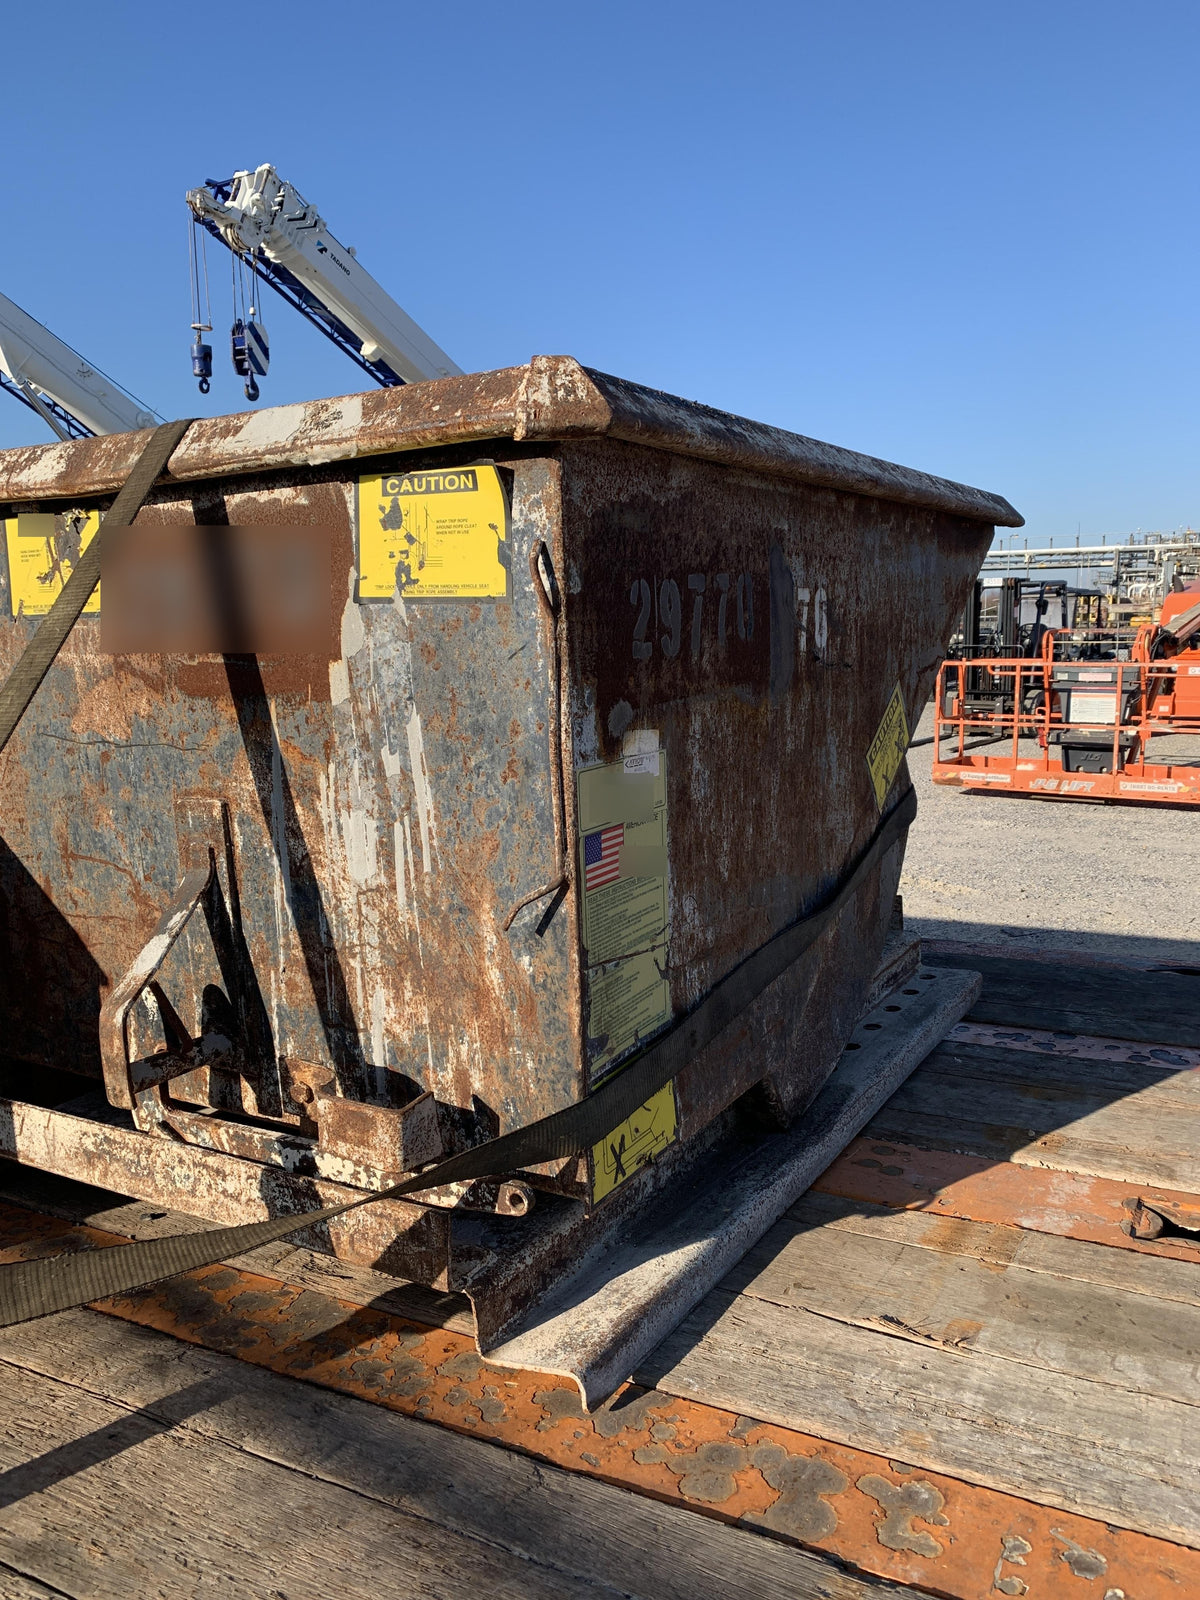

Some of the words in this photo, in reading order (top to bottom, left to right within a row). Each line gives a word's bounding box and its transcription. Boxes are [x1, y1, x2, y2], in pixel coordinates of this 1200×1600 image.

[330, 253, 351, 276] TADANO
[386, 473, 473, 494] CAUTION
[871, 697, 899, 760] CAUTION
[1081, 752, 1103, 762] JLG
[1029, 778, 1060, 790] JLG
[1060, 780, 1096, 793] LIFT
